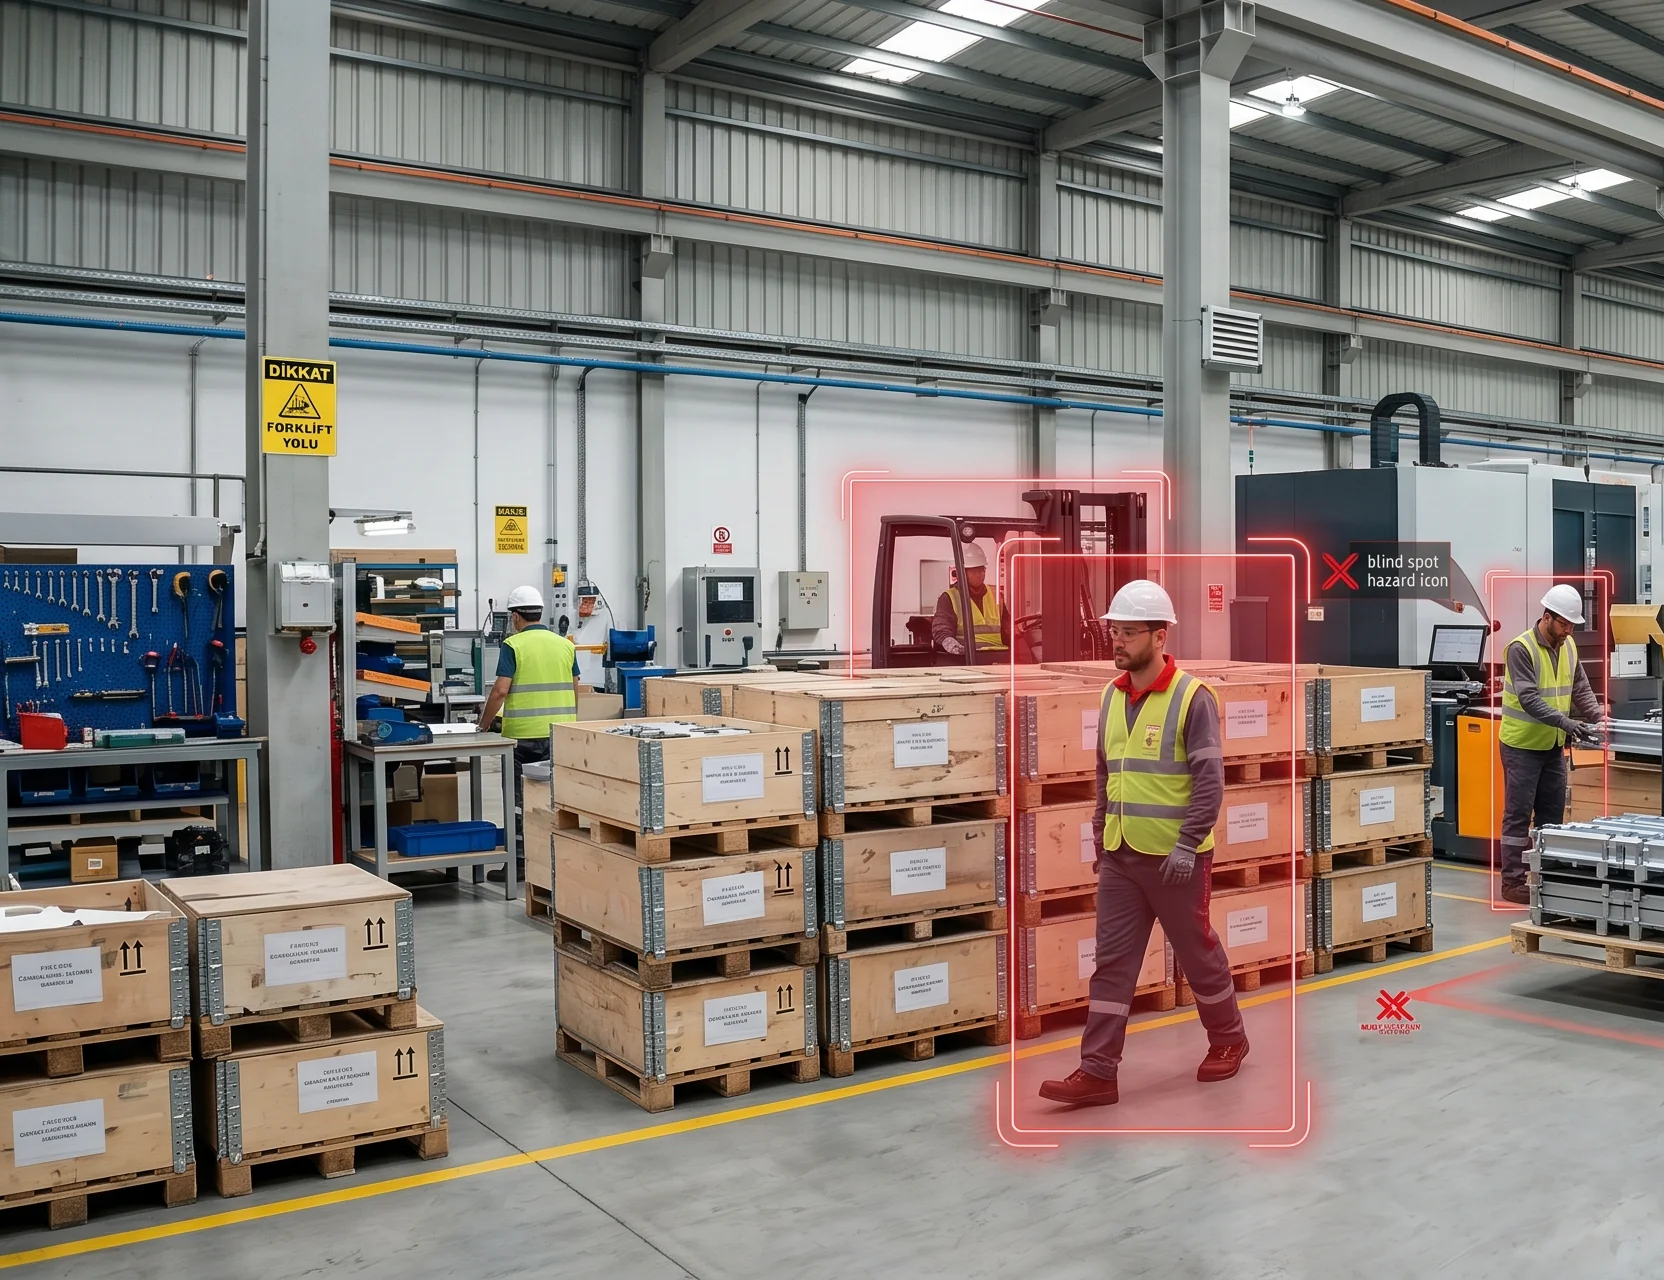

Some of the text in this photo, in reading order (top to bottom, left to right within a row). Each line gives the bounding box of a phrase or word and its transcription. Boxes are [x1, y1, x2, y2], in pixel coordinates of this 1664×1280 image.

[269, 362, 331, 381] DİKKAT
[267, 422, 332, 435] FORKLİFT
[283, 438, 318, 449] YOLU
